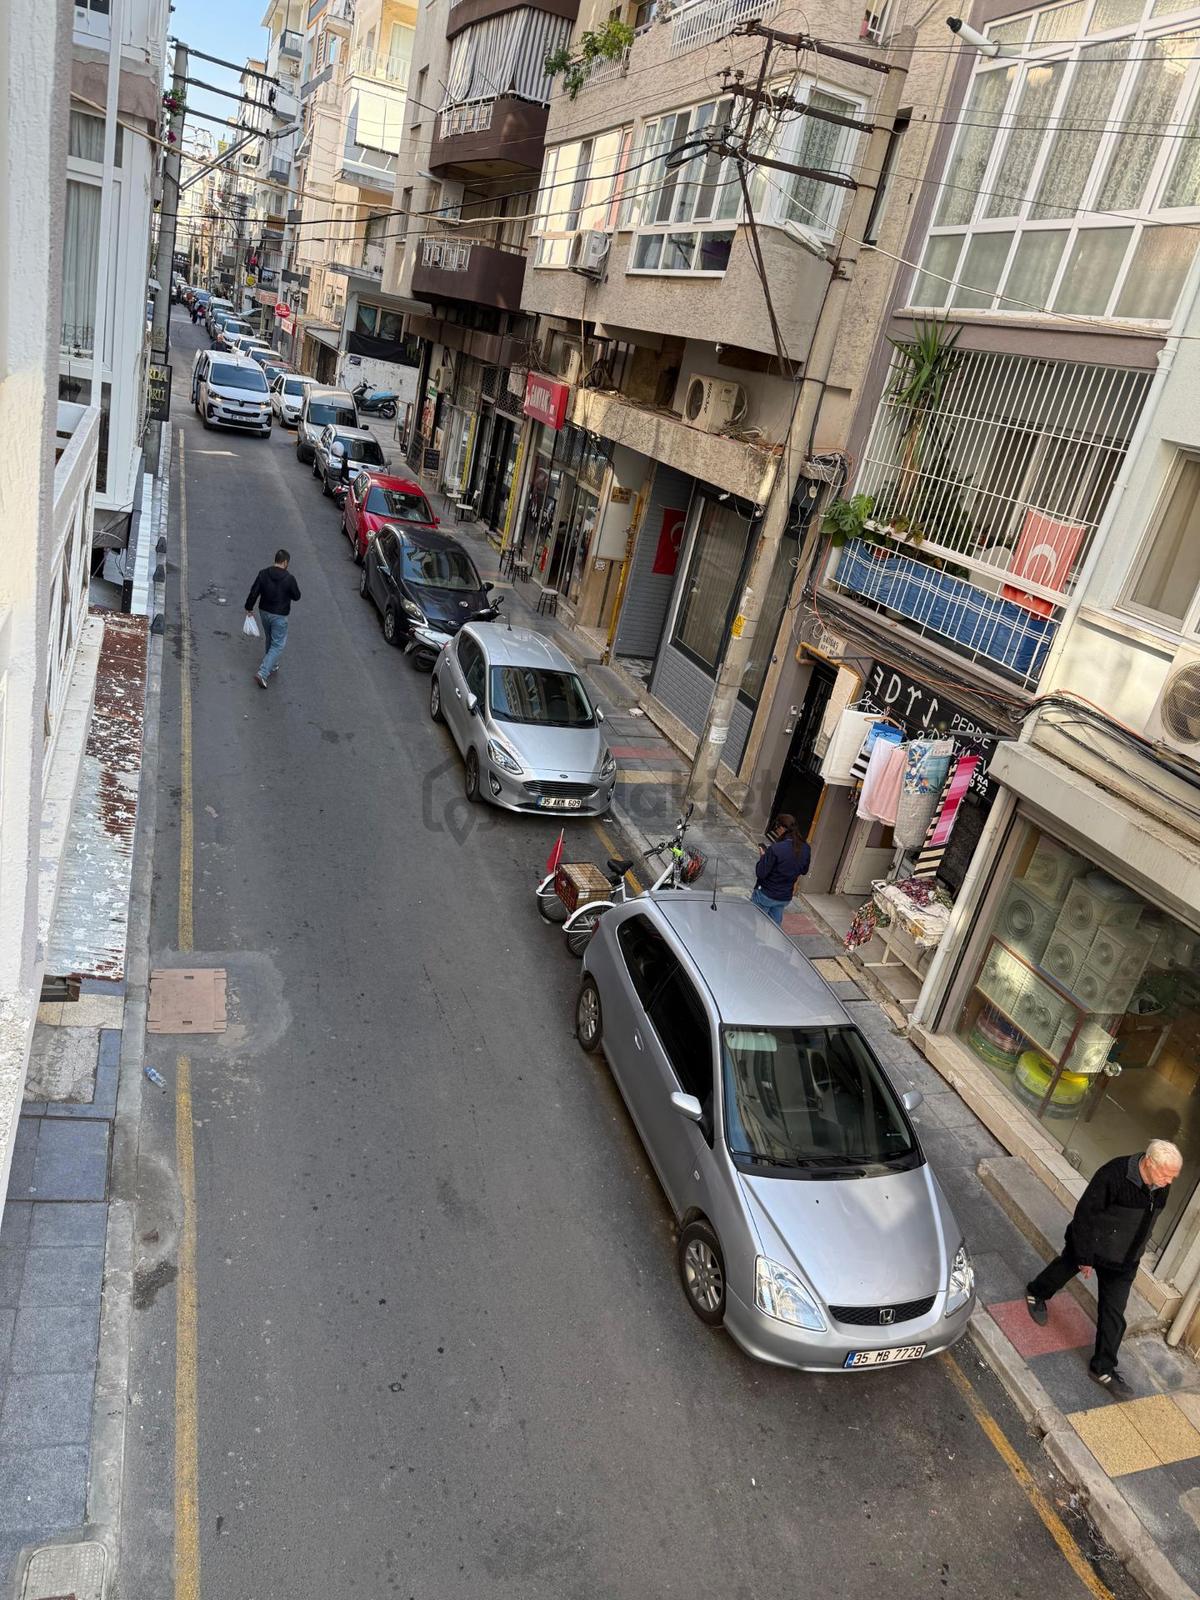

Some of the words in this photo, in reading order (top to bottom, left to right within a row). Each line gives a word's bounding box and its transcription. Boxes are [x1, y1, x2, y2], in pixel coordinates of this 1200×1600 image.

[854, 1353, 870, 1364] 35
[875, 1350, 890, 1362] MB
[894, 1347, 923, 1360] 7728
